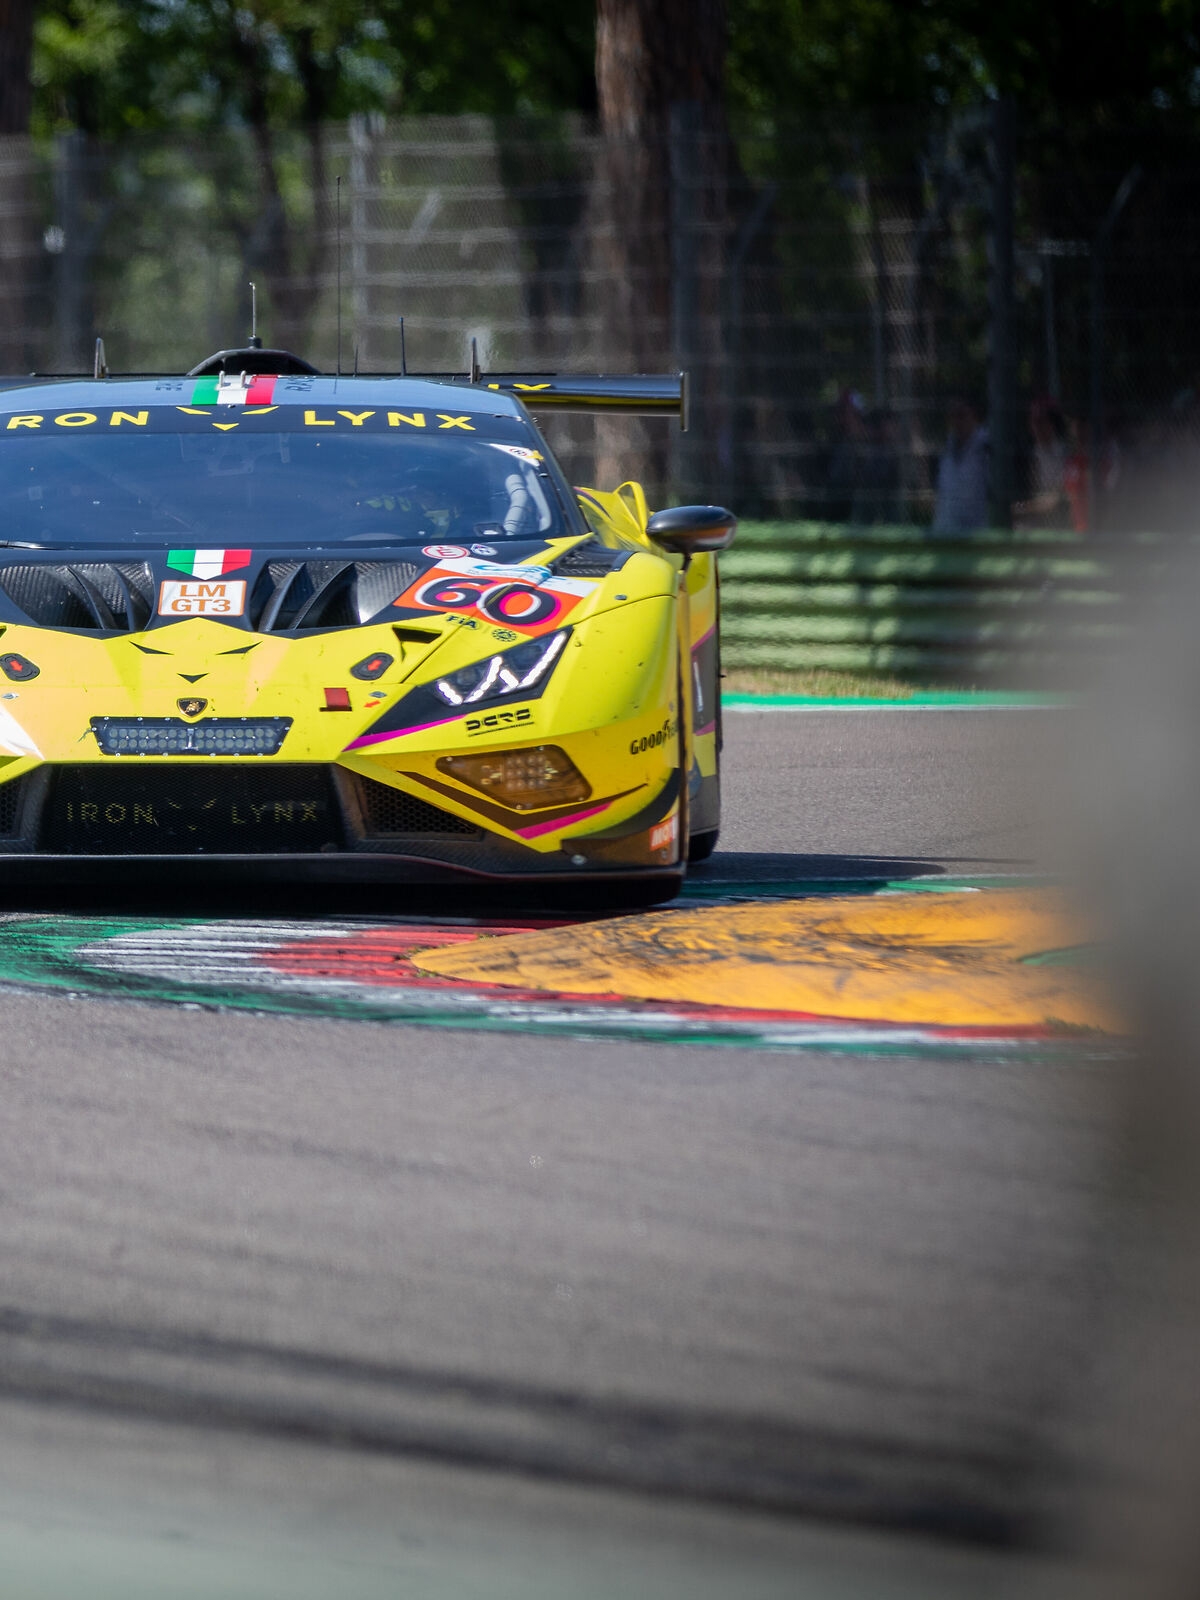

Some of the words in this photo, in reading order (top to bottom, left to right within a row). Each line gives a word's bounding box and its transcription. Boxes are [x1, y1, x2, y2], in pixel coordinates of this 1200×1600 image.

[304, 410, 476, 431] LYNX
[180, 585, 226, 597] LM
[414, 576, 562, 627] 60
[171, 599, 231, 612] GT3
[67, 802, 153, 824] IRON
[232, 801, 318, 824] LYNX
